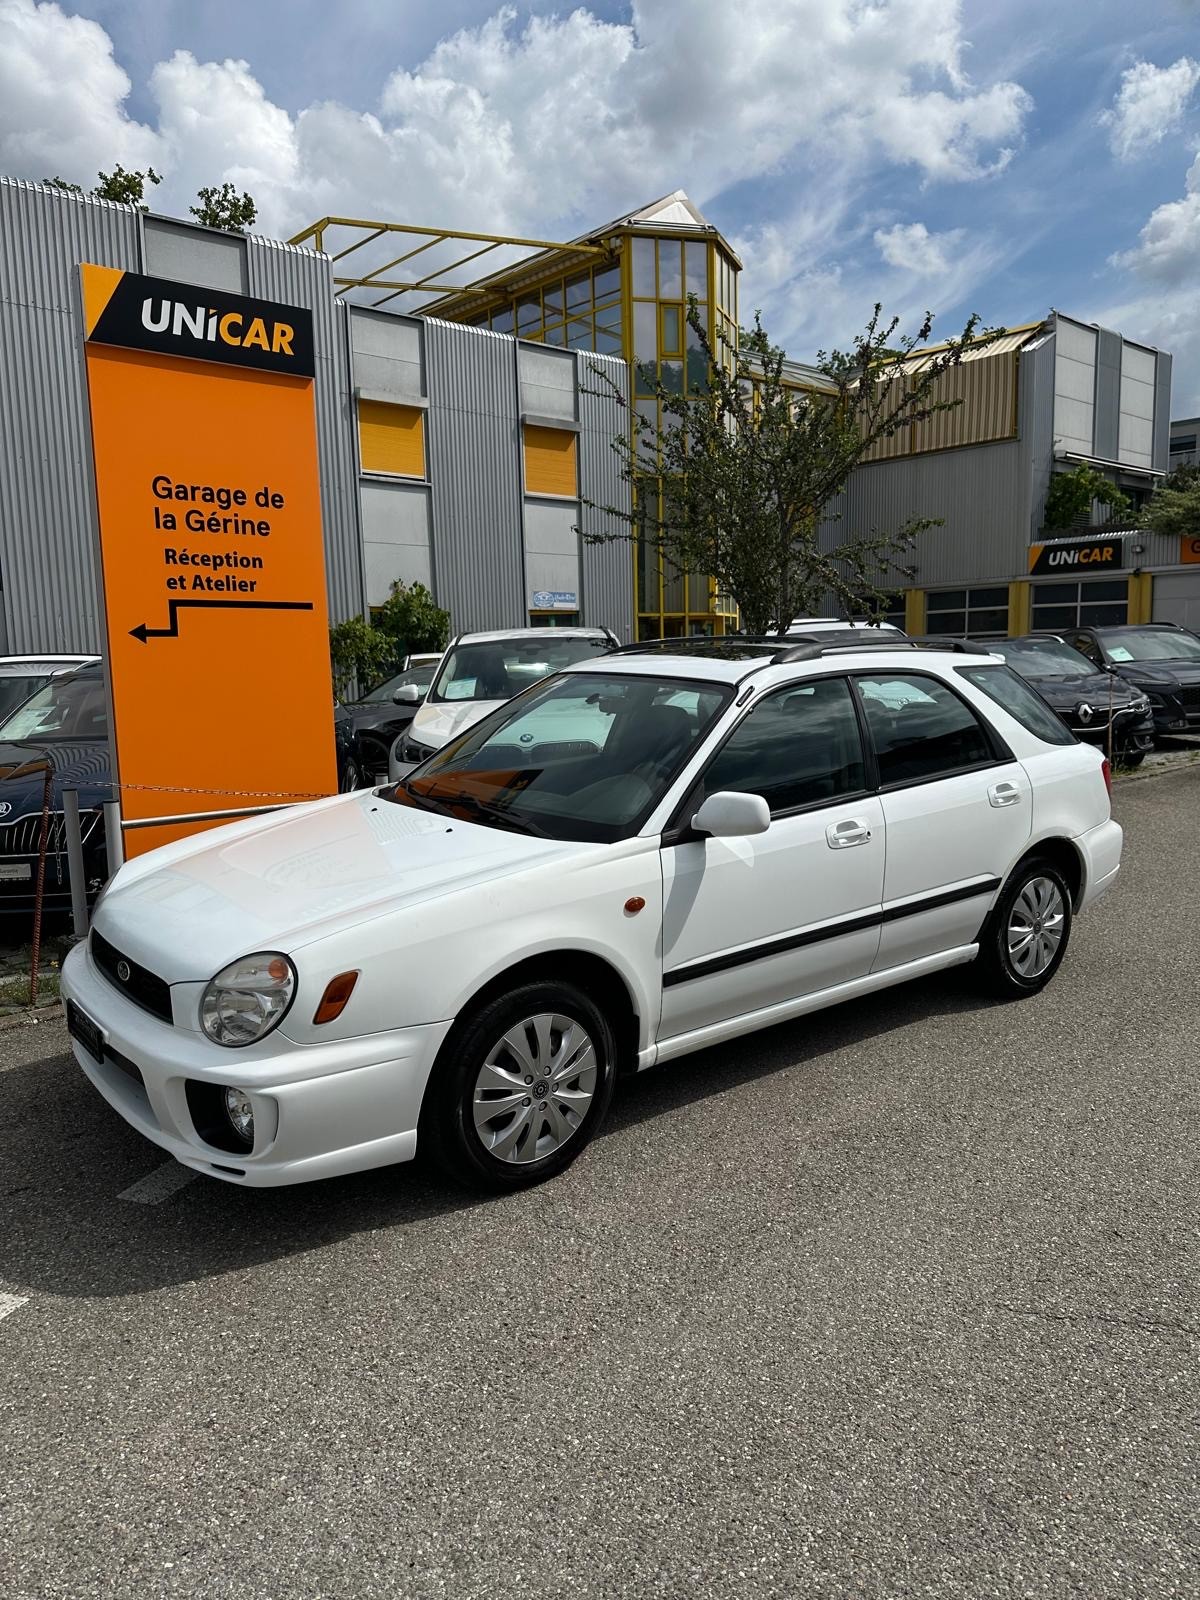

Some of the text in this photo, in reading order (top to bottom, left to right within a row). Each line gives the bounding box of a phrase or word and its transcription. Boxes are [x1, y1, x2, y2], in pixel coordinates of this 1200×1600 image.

[151, 475, 285, 510] Garage de
[154, 506, 271, 537] la Gérine
[164, 548, 263, 571] Réception
[166, 574, 257, 592] et Atelier
